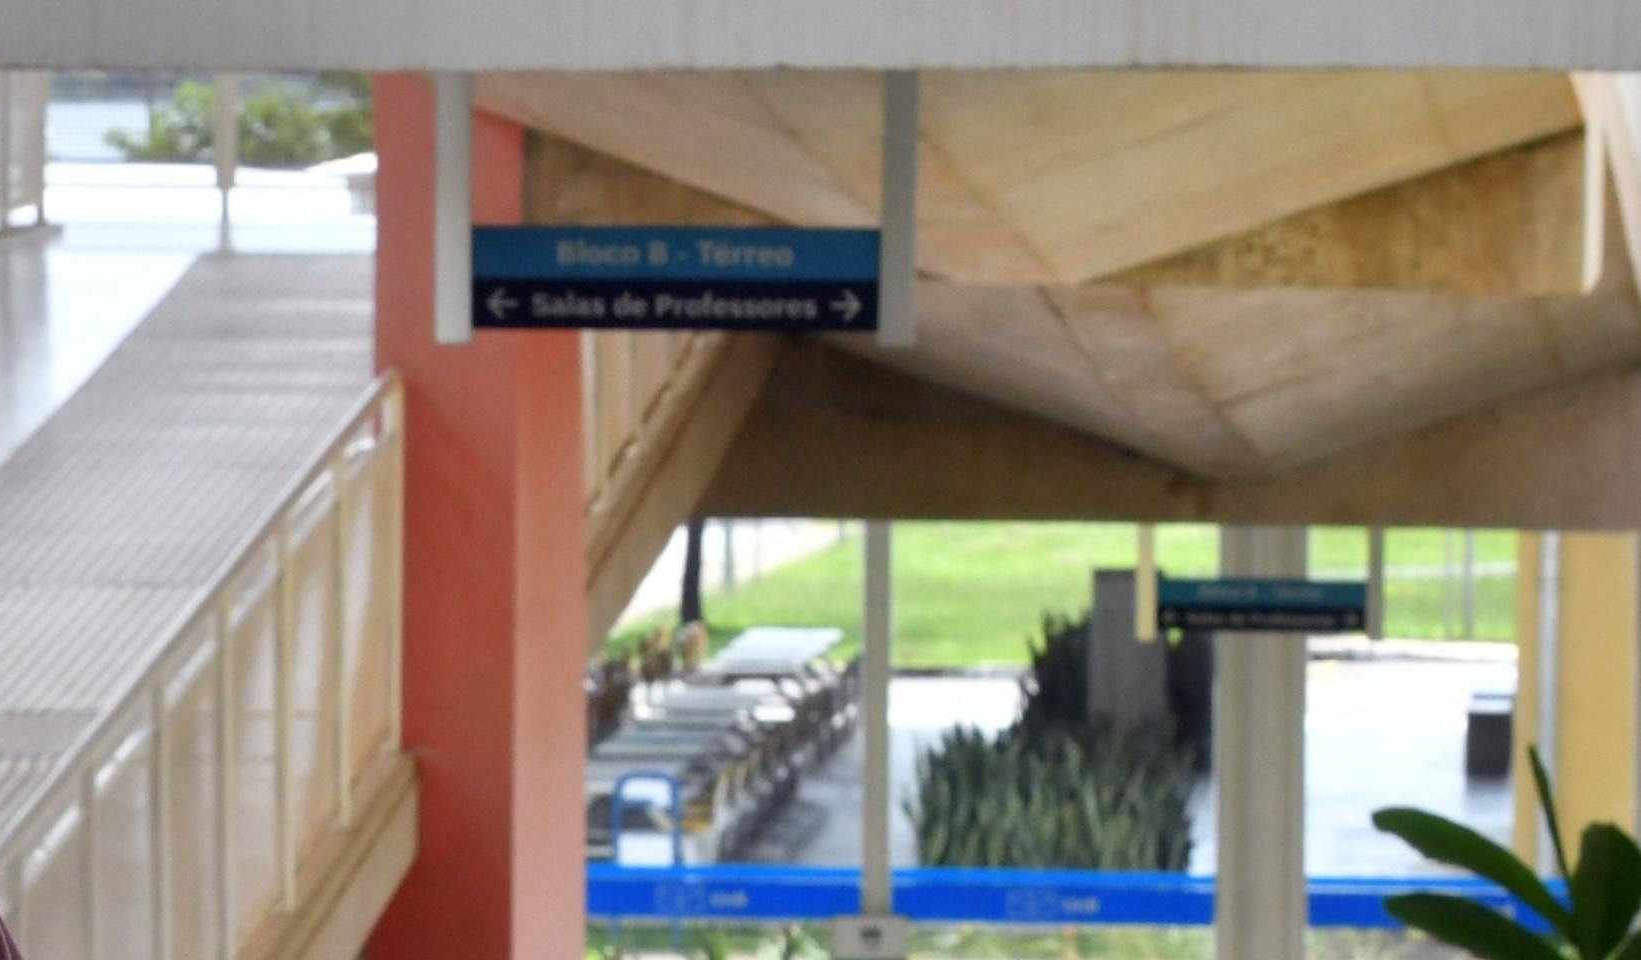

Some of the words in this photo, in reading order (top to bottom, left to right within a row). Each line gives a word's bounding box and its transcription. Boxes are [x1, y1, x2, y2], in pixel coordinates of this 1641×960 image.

[556, 238, 641, 267] Bloco
[695, 235, 795, 267] Térreo
[531, 290, 606, 319] Salas
[613, 290, 648, 319] de
[654, 290, 818, 319] Professores
